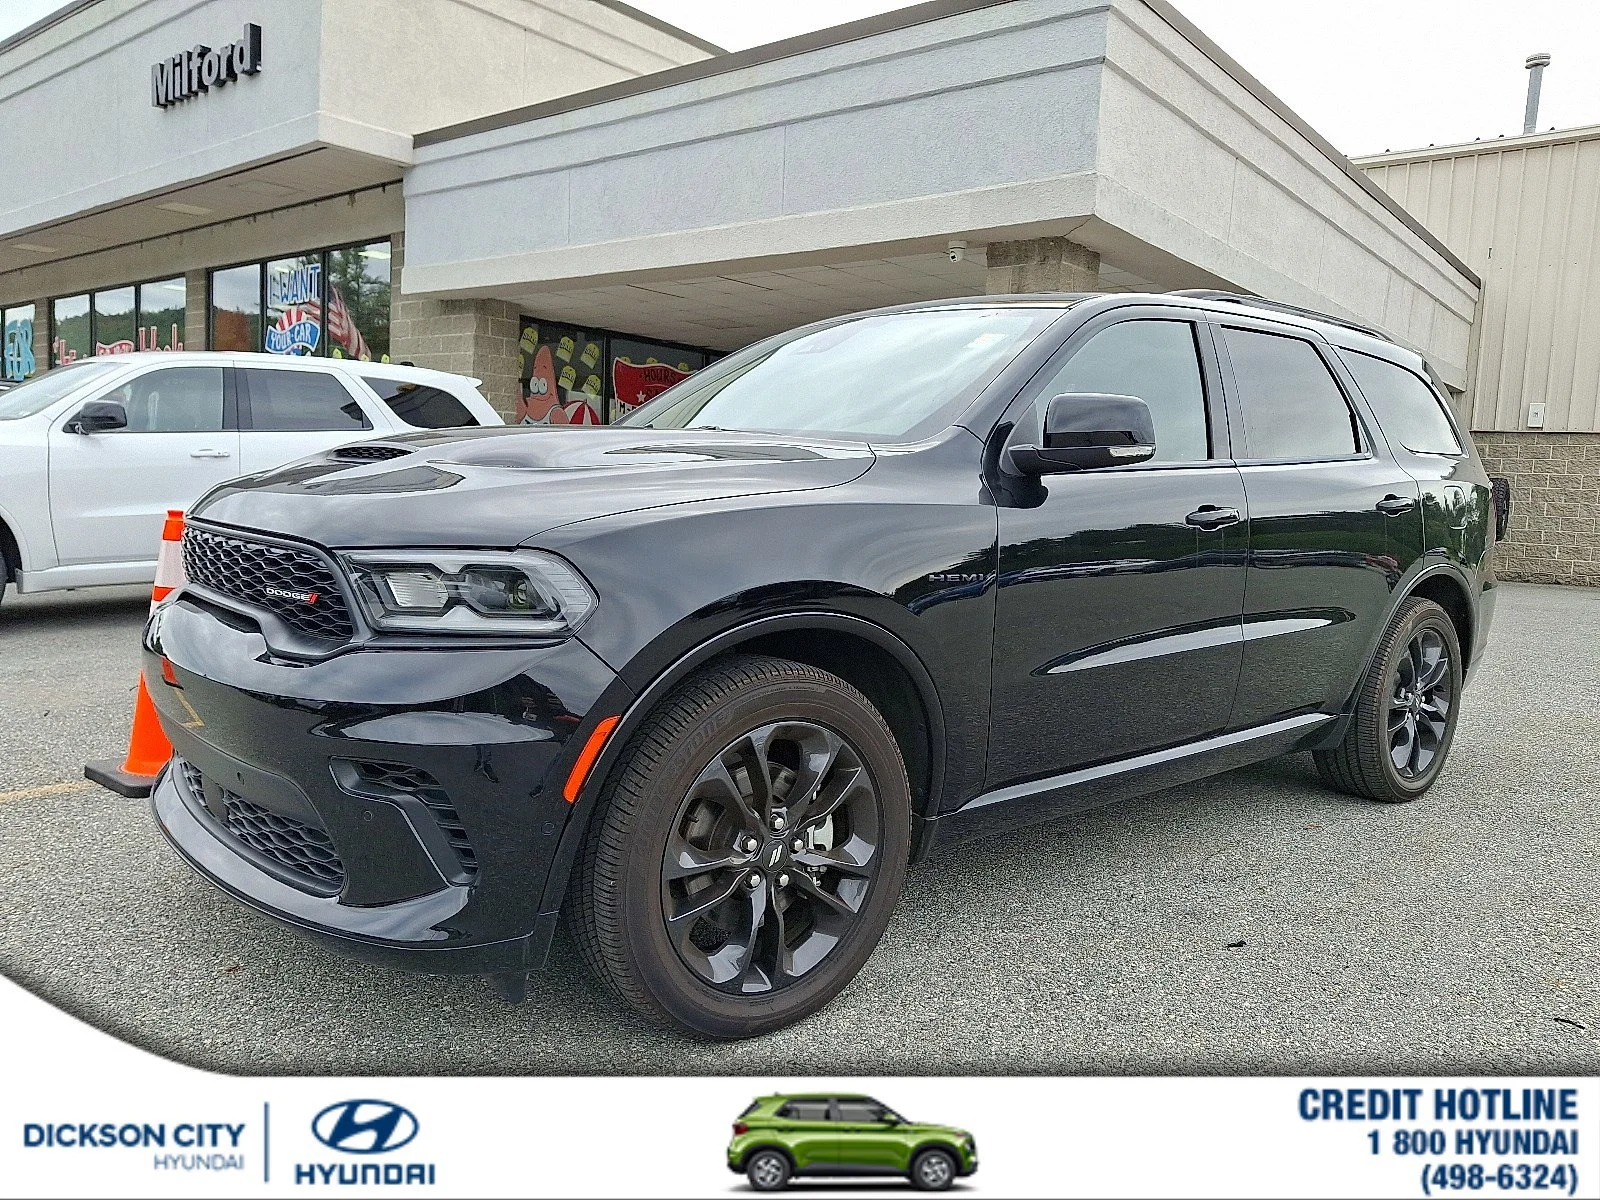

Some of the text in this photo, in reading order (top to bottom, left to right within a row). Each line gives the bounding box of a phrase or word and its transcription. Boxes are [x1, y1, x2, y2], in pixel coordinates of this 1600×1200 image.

[151, 23, 262, 112] Milford
[280, 264, 321, 304] WANT
[295, 322, 311, 343] CAR
[644, 367, 677, 382] HOURS
[928, 573, 984, 582] HEMI
[266, 587, 310, 601] DODGE
